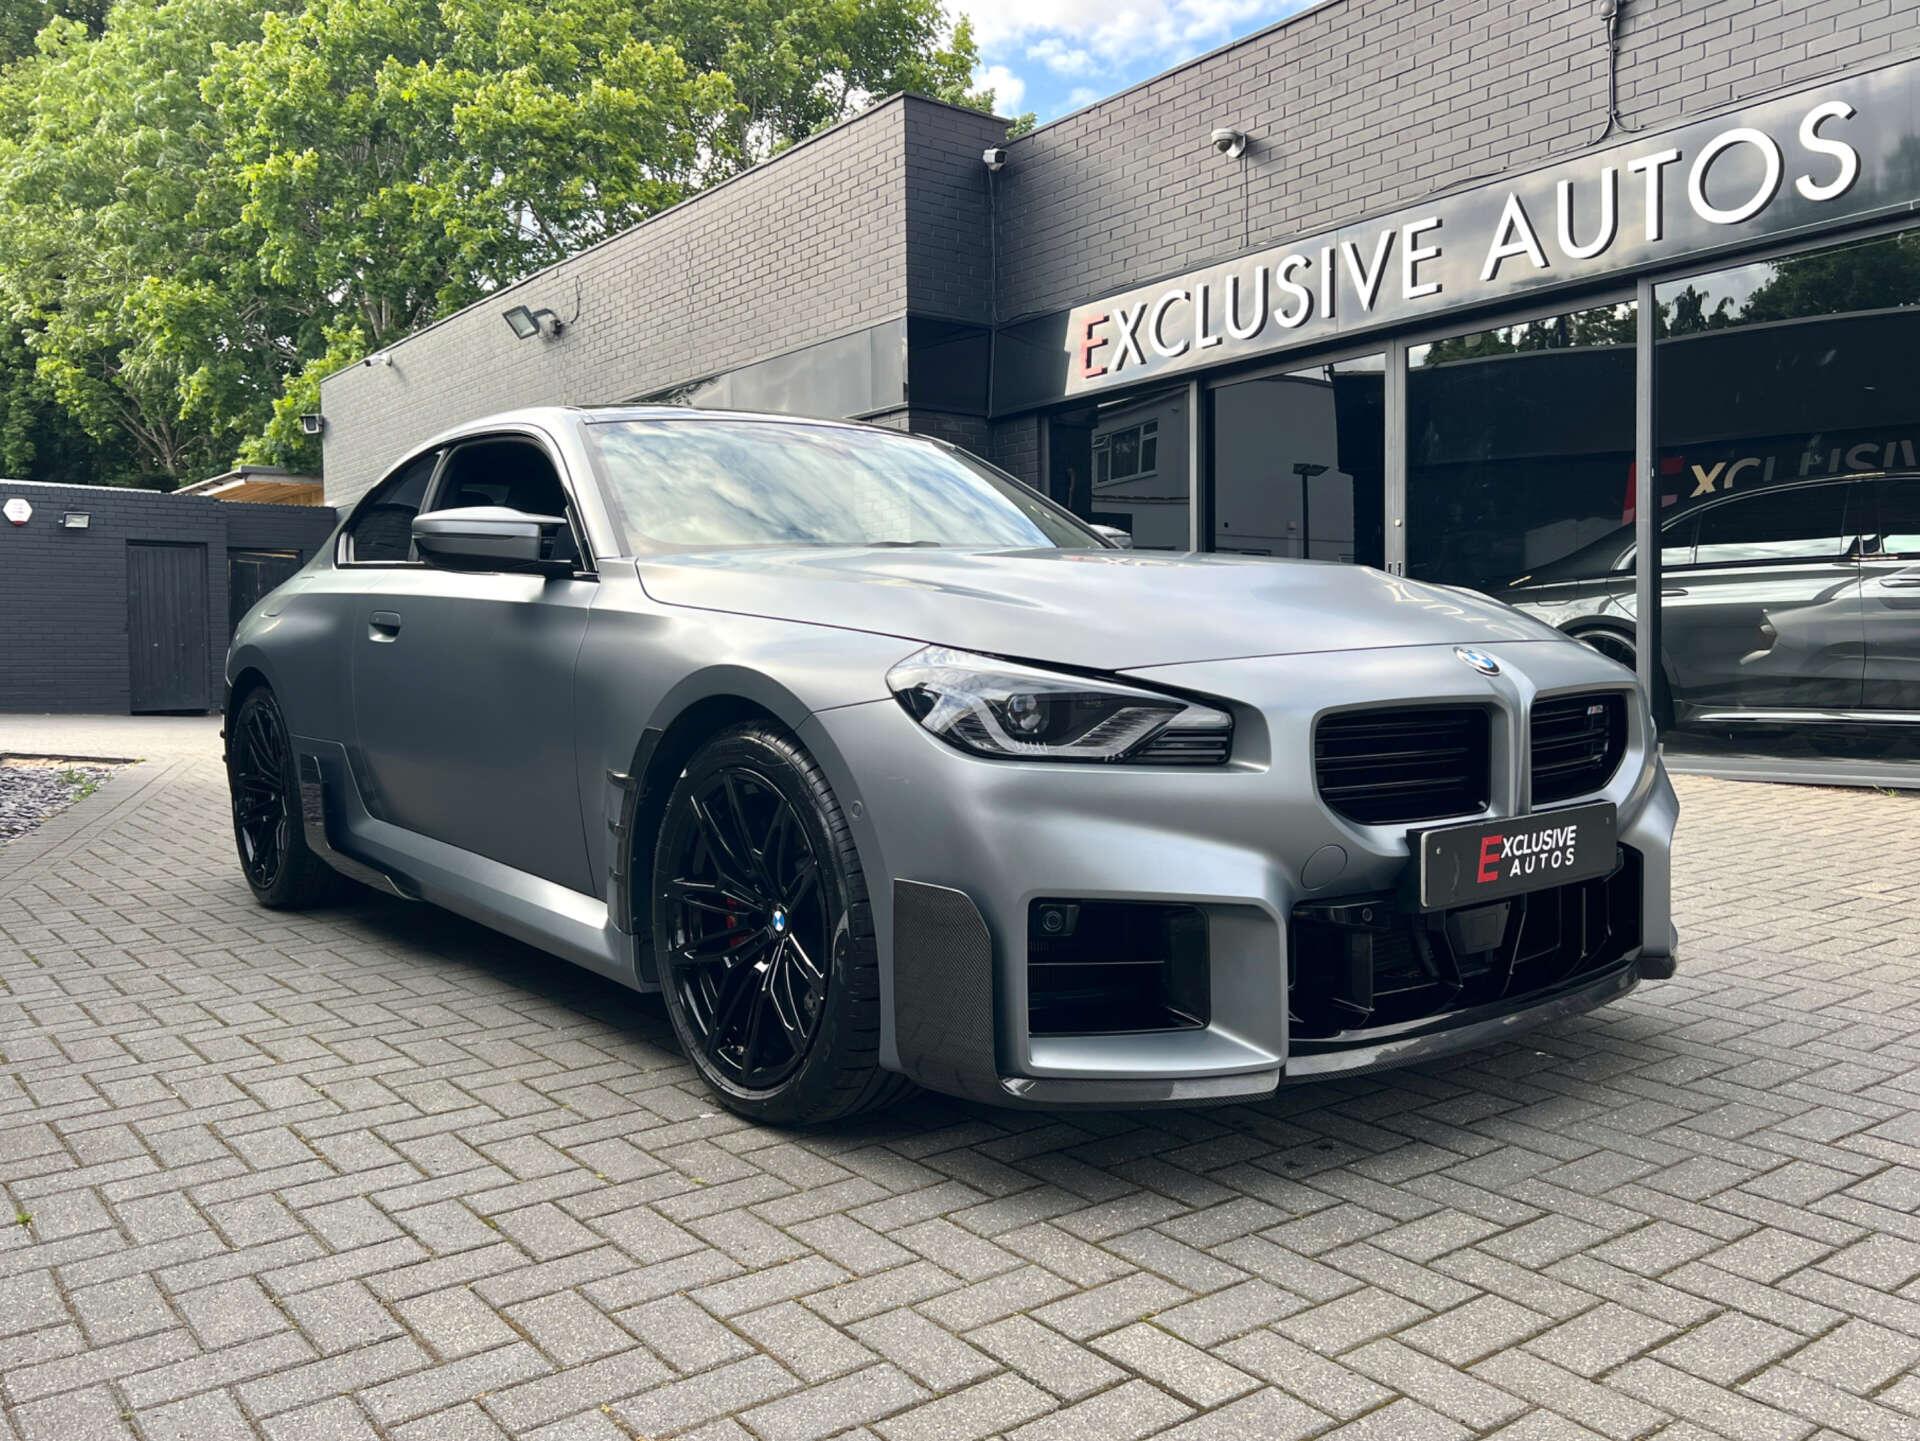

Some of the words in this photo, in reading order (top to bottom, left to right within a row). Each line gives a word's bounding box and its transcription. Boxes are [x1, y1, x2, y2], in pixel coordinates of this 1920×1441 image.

[1079, 216, 1443, 379] EXCLUSIVE
[1479, 100, 1861, 282] AUTOS
[1476, 825, 1577, 884] EXCLUSIVE
[1509, 847, 1575, 877] AUTOS
